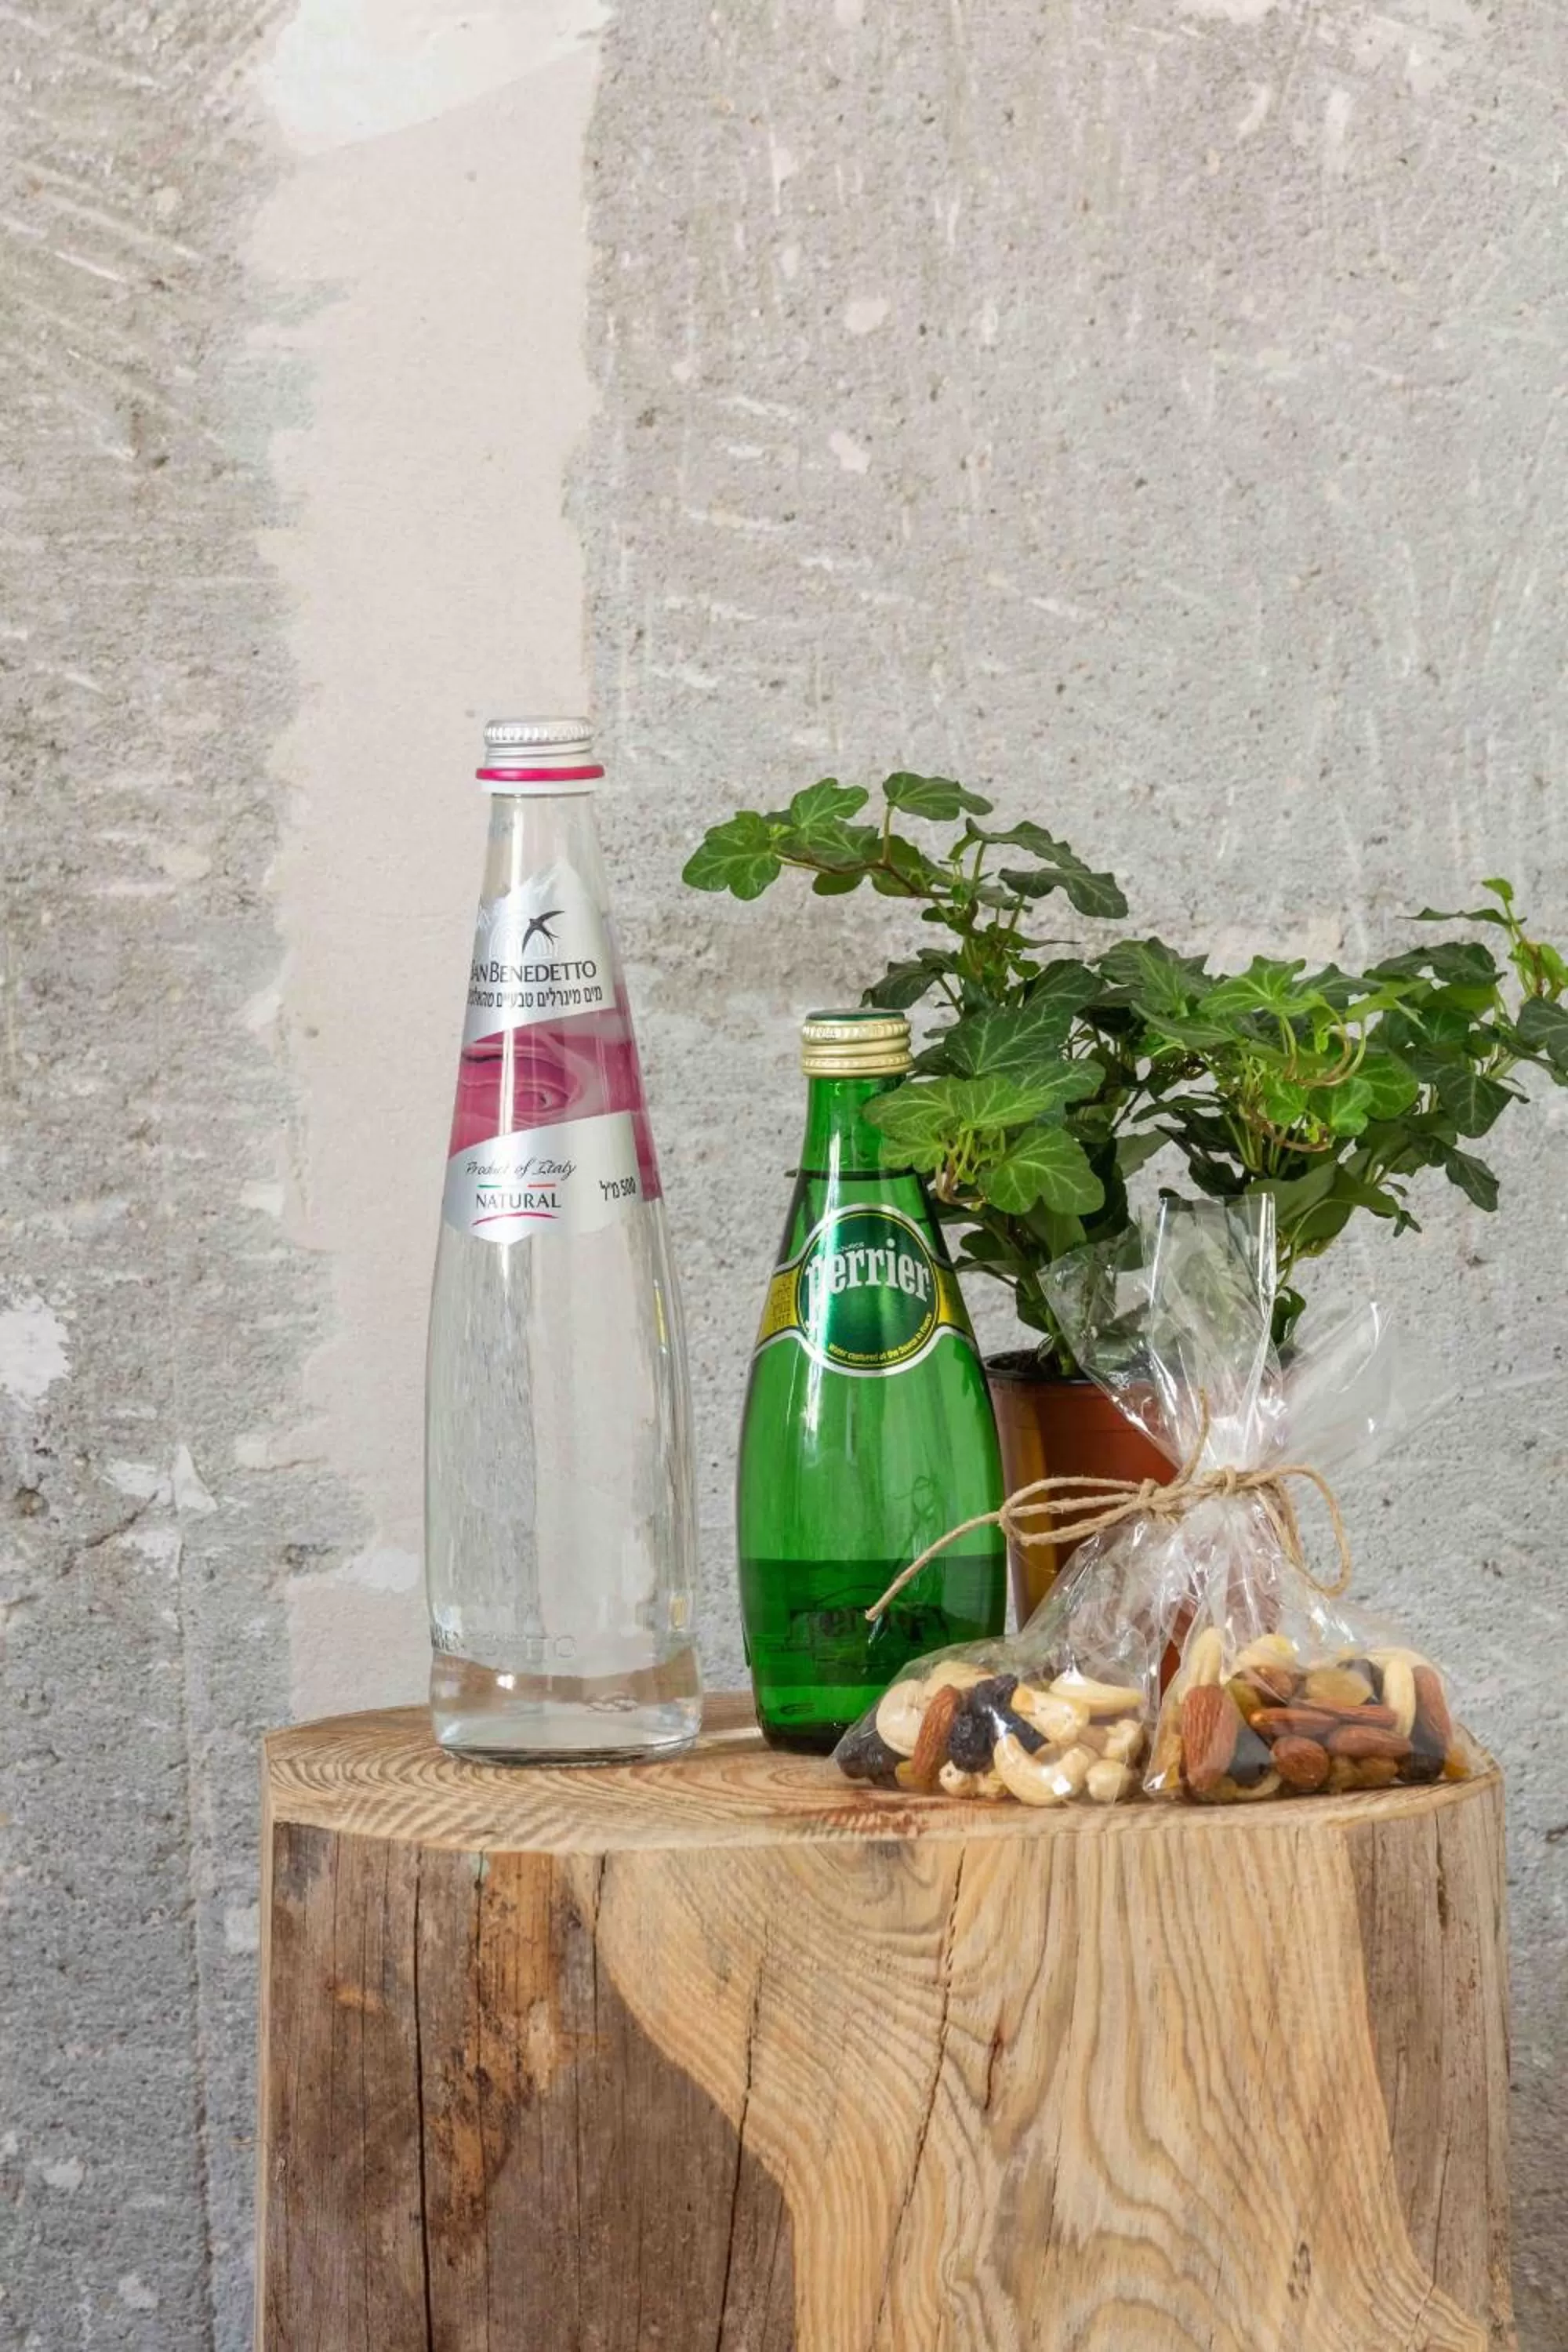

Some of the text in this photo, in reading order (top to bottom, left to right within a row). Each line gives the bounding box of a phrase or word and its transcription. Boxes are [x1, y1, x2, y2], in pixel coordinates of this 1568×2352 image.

[537, 988, 581, 1007] מינרלים
[583, 986, 602, 1002] מים
[514, 1158, 535, 1179] of
[533, 1159, 576, 1181] Italy
[476, 1192, 561, 1209] NATURAL
